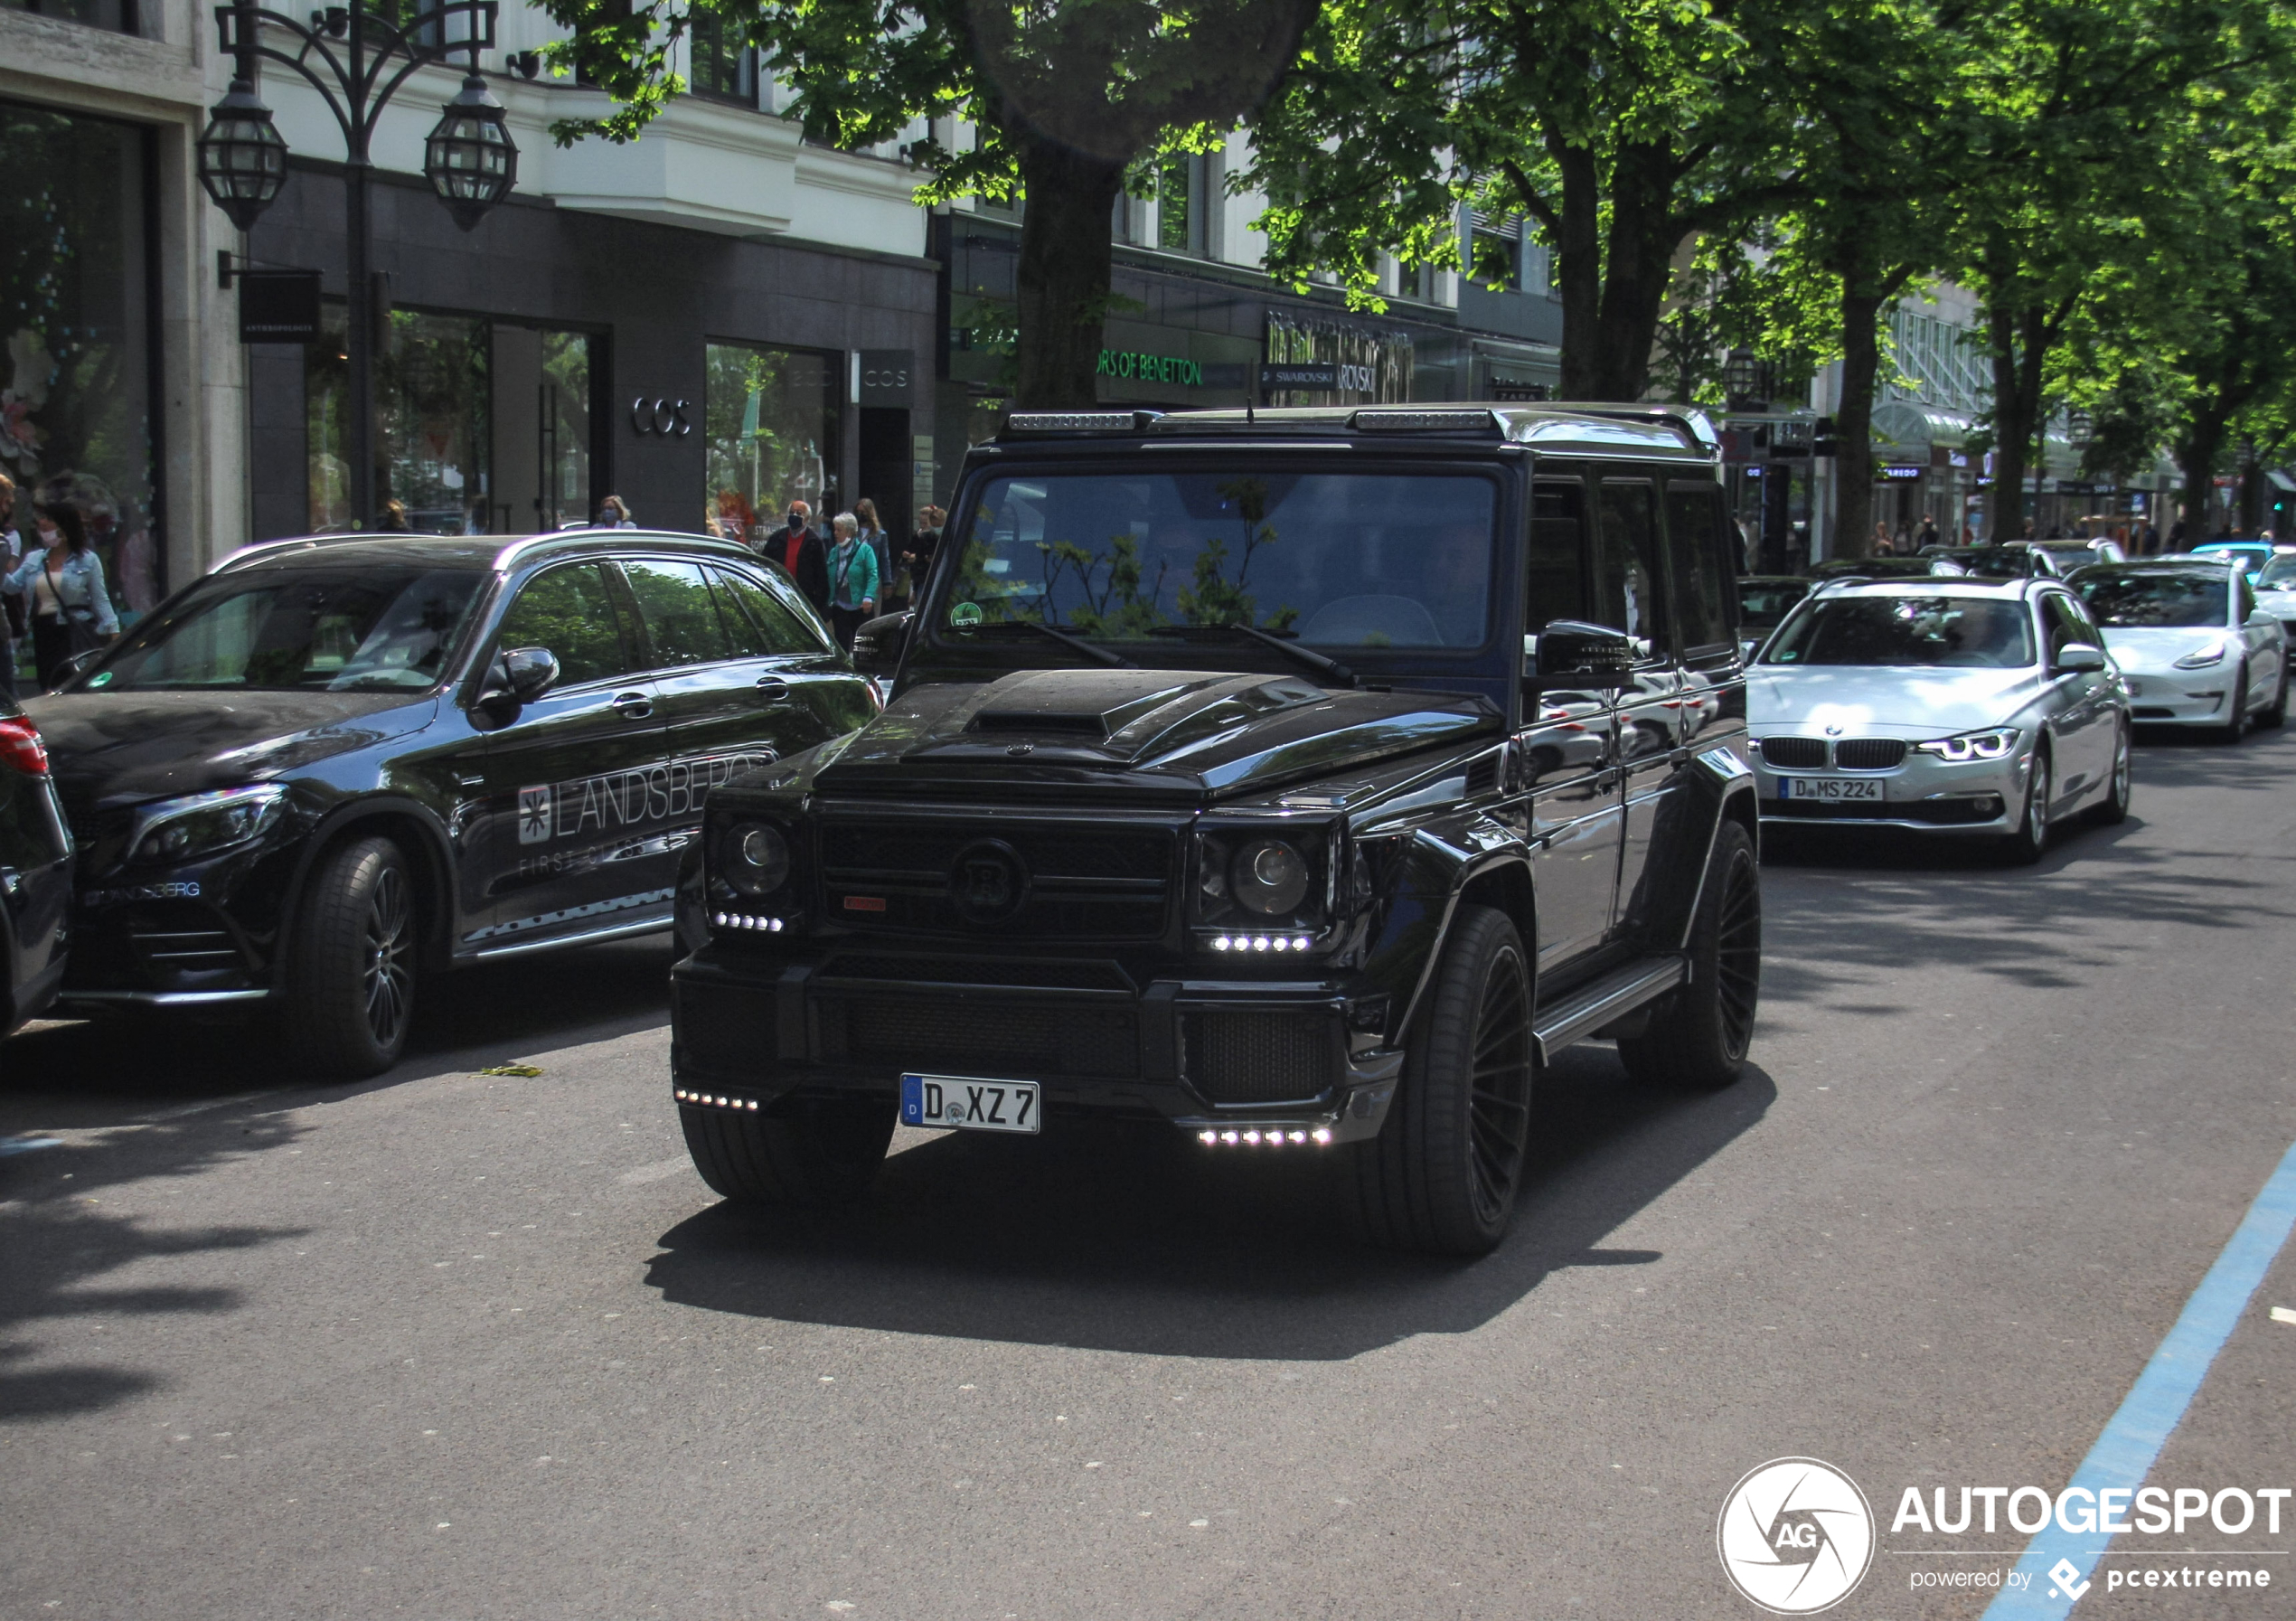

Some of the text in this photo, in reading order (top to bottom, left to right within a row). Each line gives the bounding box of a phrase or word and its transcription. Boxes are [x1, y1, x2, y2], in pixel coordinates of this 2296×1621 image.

[1119, 352, 1137, 379] OF
[864, 370, 908, 387] COS
[1276, 371, 1333, 383] SWAROVSKI
[1501, 392, 1537, 401] ZARA
[634, 397, 691, 435] COS
[1795, 779, 1806, 796] D
[1817, 781, 1840, 798] MS
[1843, 781, 1876, 798] 224
[519, 851, 574, 878] FIRST
[908, 1104, 917, 1115] D
[925, 1083, 1034, 1125] D XZ 7
